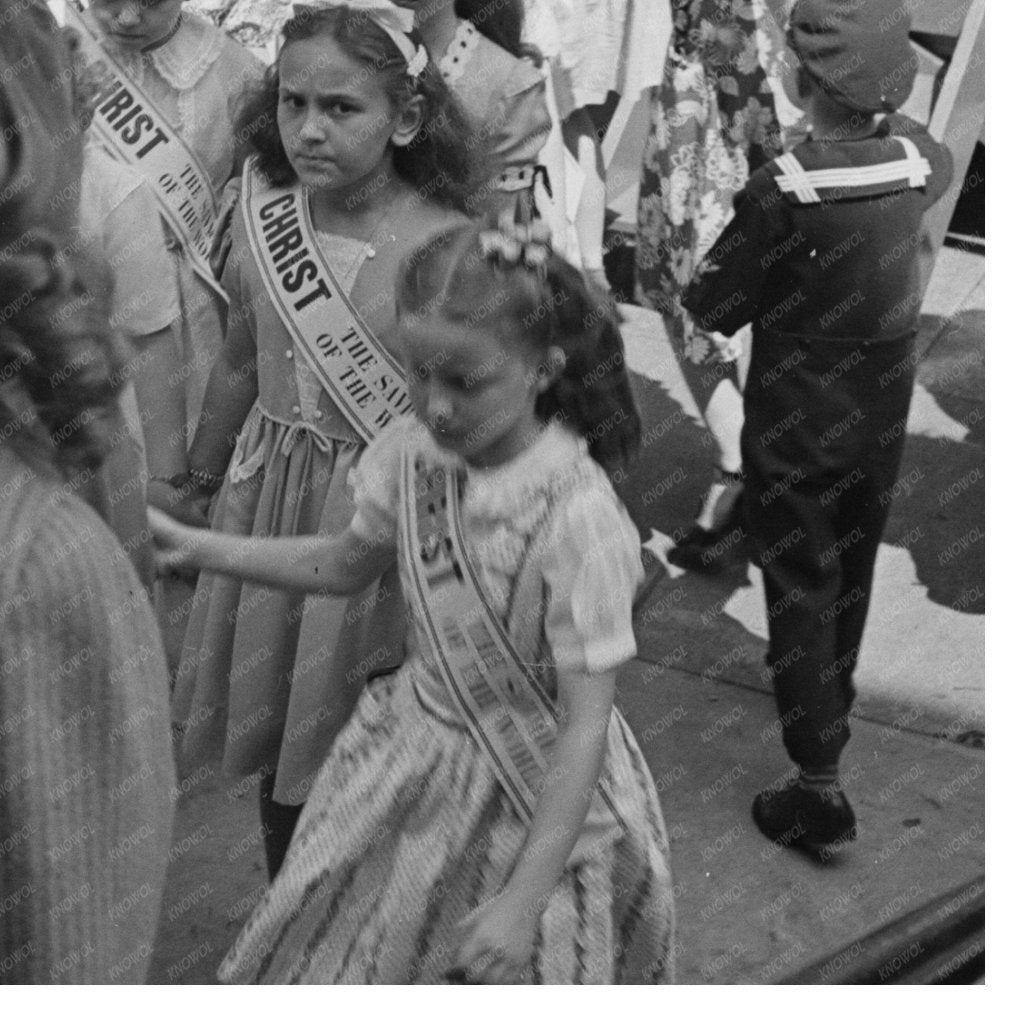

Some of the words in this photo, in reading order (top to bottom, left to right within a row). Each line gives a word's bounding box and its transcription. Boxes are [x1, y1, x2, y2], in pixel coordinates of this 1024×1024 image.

[259, 193, 332, 312] CHRIST
[315, 333, 343, 361] OF
[338, 366, 377, 409] THE
[340, 326, 378, 373] THE
